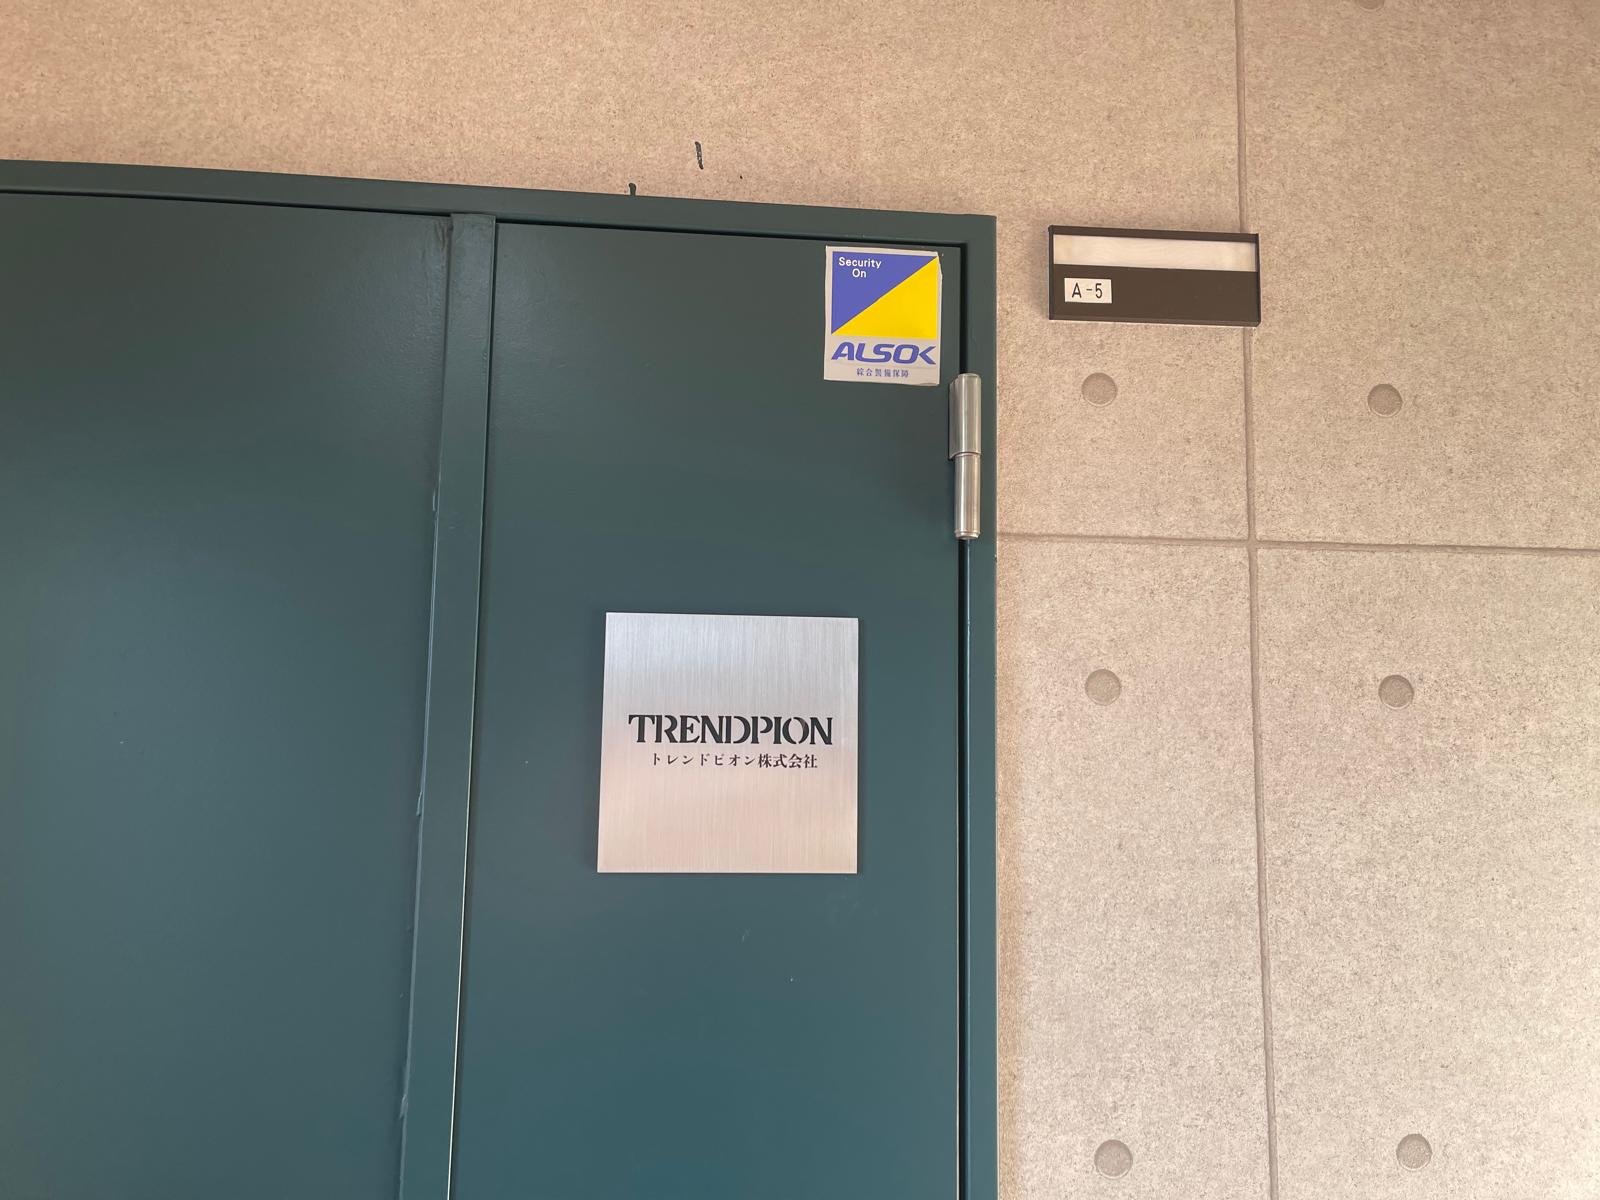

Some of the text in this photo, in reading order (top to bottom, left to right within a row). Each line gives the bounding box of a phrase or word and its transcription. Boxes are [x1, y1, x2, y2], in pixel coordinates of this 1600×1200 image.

[839, 256, 882, 269] Security
[852, 268, 867, 278] On
[1071, 282, 1103, 299] A-5
[831, 341, 936, 365] ALSOK
[628, 714, 833, 745] TRENDPION
